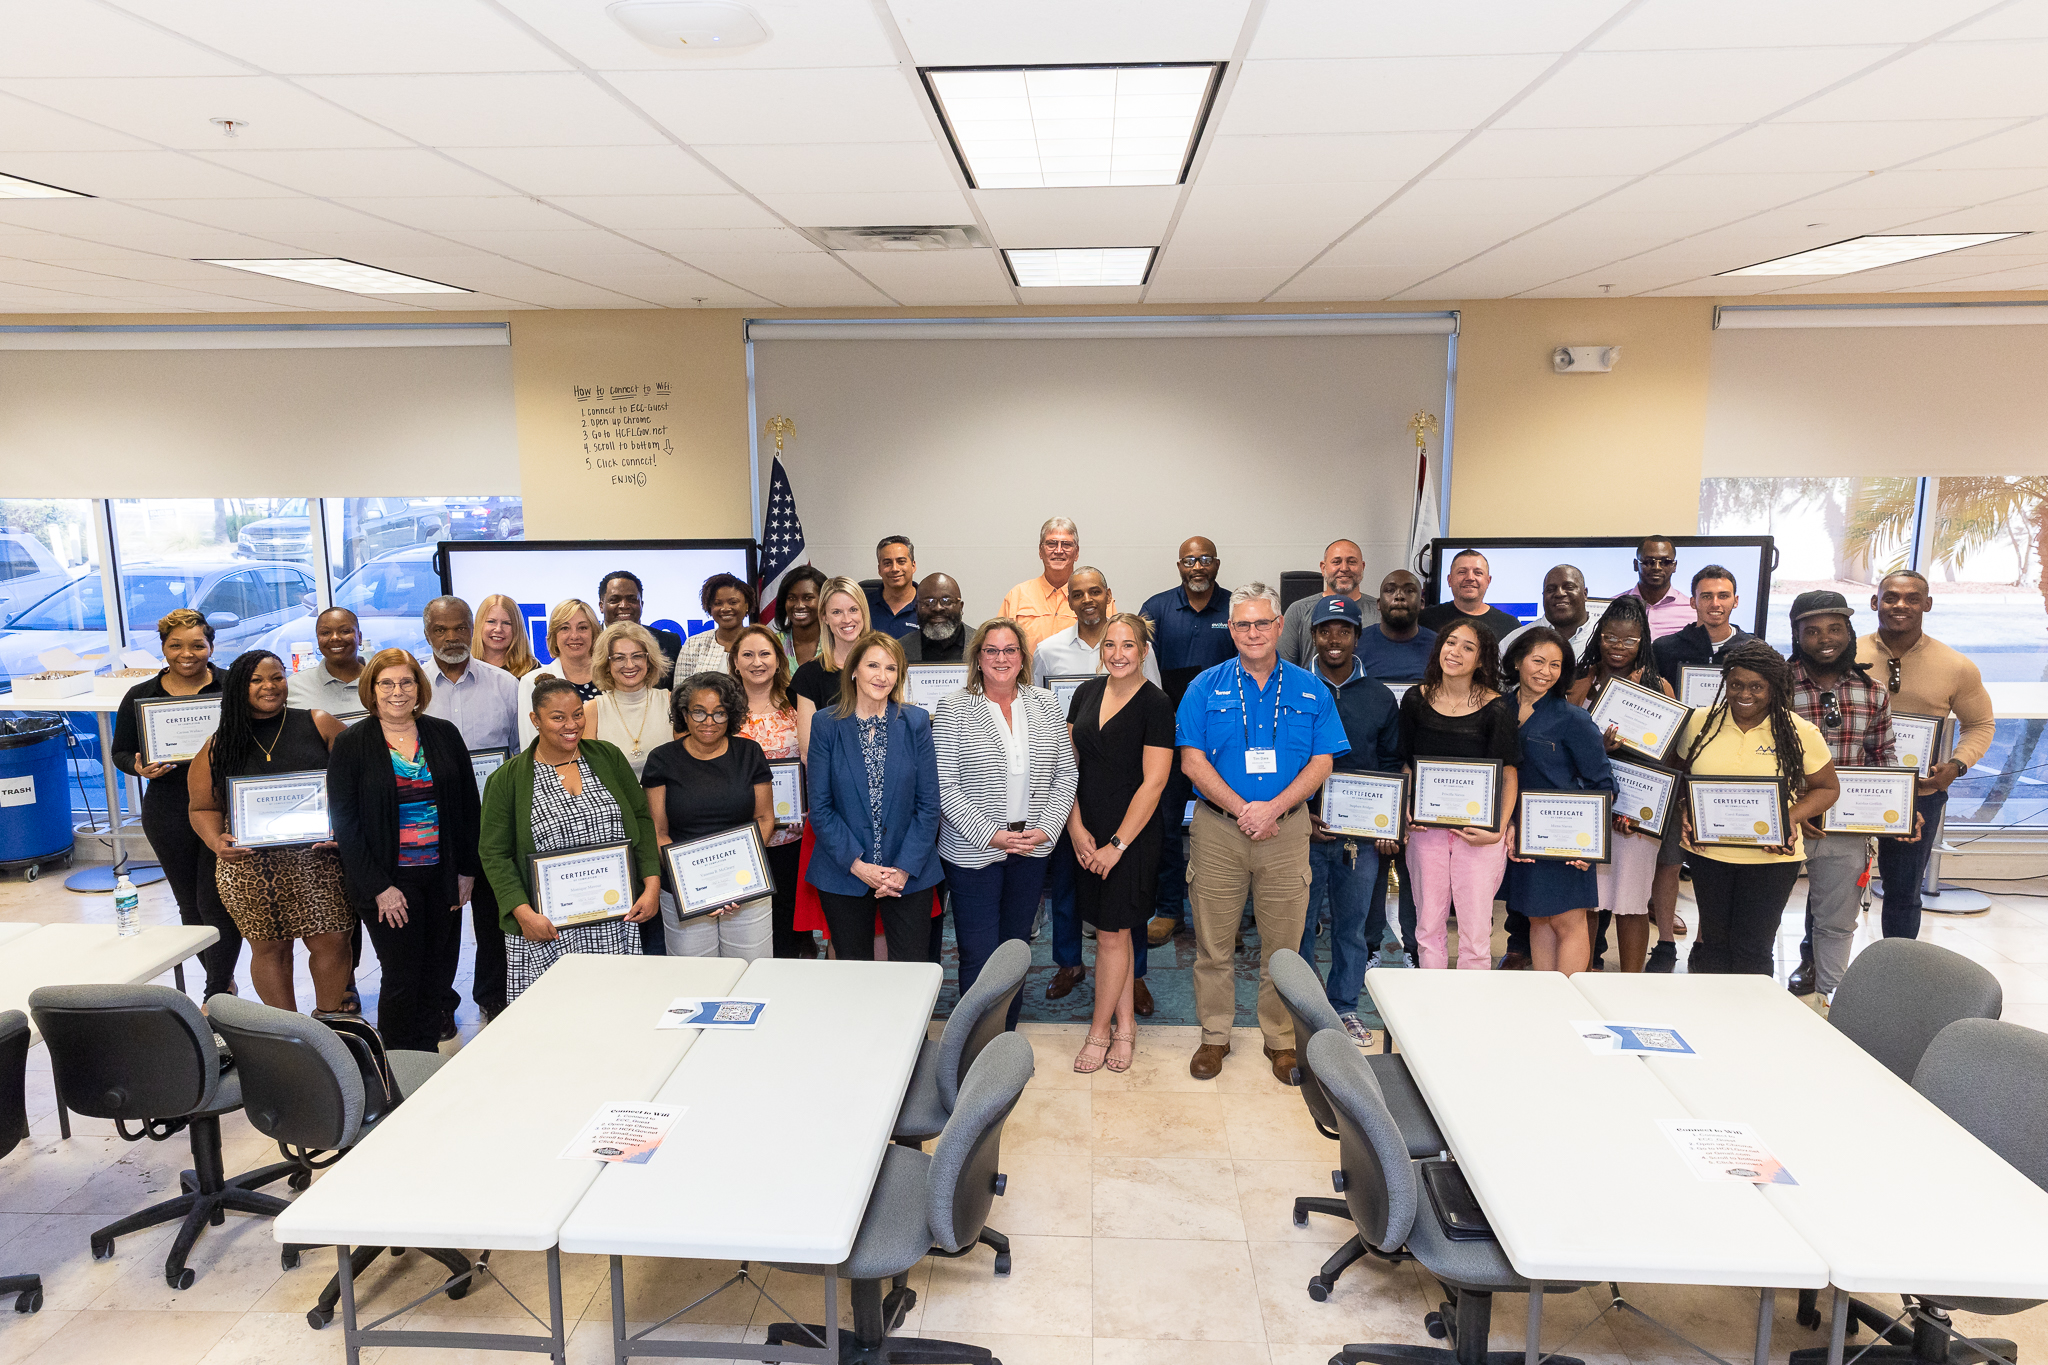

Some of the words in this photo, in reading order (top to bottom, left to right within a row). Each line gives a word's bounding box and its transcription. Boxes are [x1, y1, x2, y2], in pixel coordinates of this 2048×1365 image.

[574, 385, 591, 396] How
[597, 385, 604, 395] to
[643, 384, 651, 393] to
[619, 405, 627, 413] to
[631, 402, 669, 412] ECC-Guest
[592, 430, 601, 439] Go
[616, 425, 668, 437] HCFLGov.net
[584, 443, 591, 454] 4.
[619, 442, 627, 450] to
[631, 441, 660, 450] bottom
[612, 474, 636, 485] ENJOY
[1622, 700, 1662, 719] CERTIFICATE
[166, 715, 211, 723] CERTIFICATE
[2, 787, 31, 795] TRASH
[1342, 790, 1383, 798] CERTIFICATE
[692, 849, 736, 866] CERTIFICATE
[561, 867, 608, 880] CERTIFICATE
